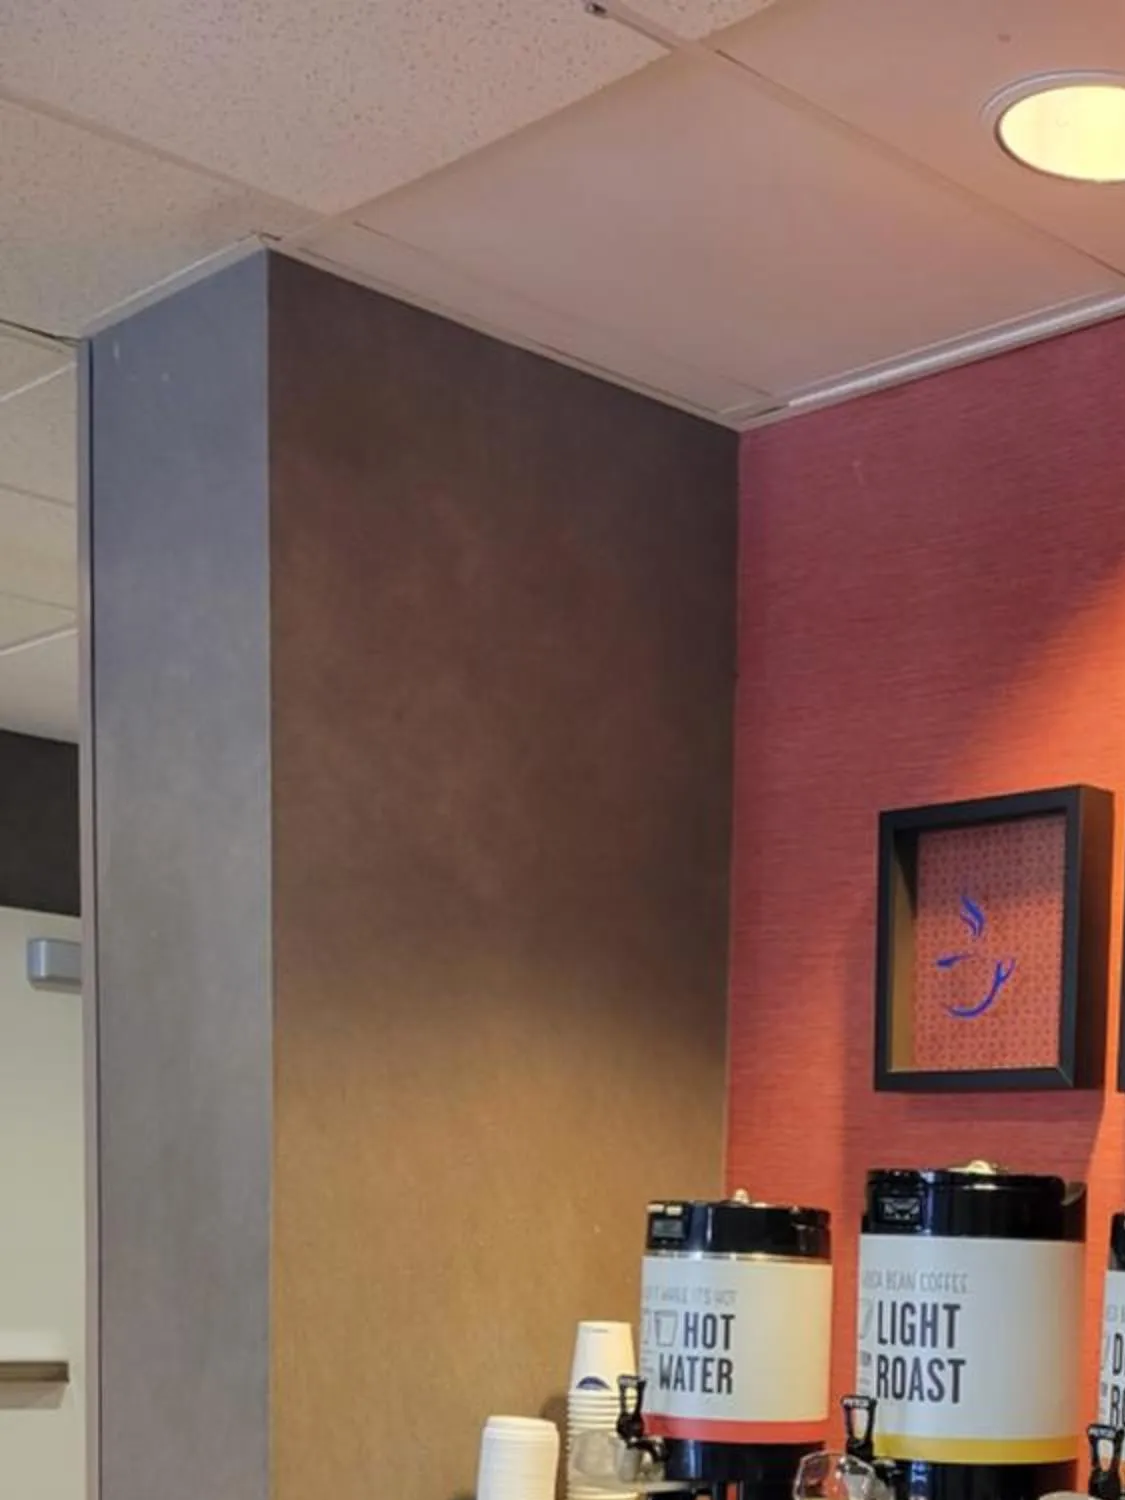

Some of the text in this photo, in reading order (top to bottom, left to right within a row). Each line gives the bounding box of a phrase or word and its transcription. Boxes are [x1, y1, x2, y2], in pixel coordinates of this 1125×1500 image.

[683, 1311, 736, 1351] HOT
[877, 1300, 961, 1349] LIGHT
[658, 1351, 734, 1395] WATER
[876, 1354, 967, 1404] ROAST
